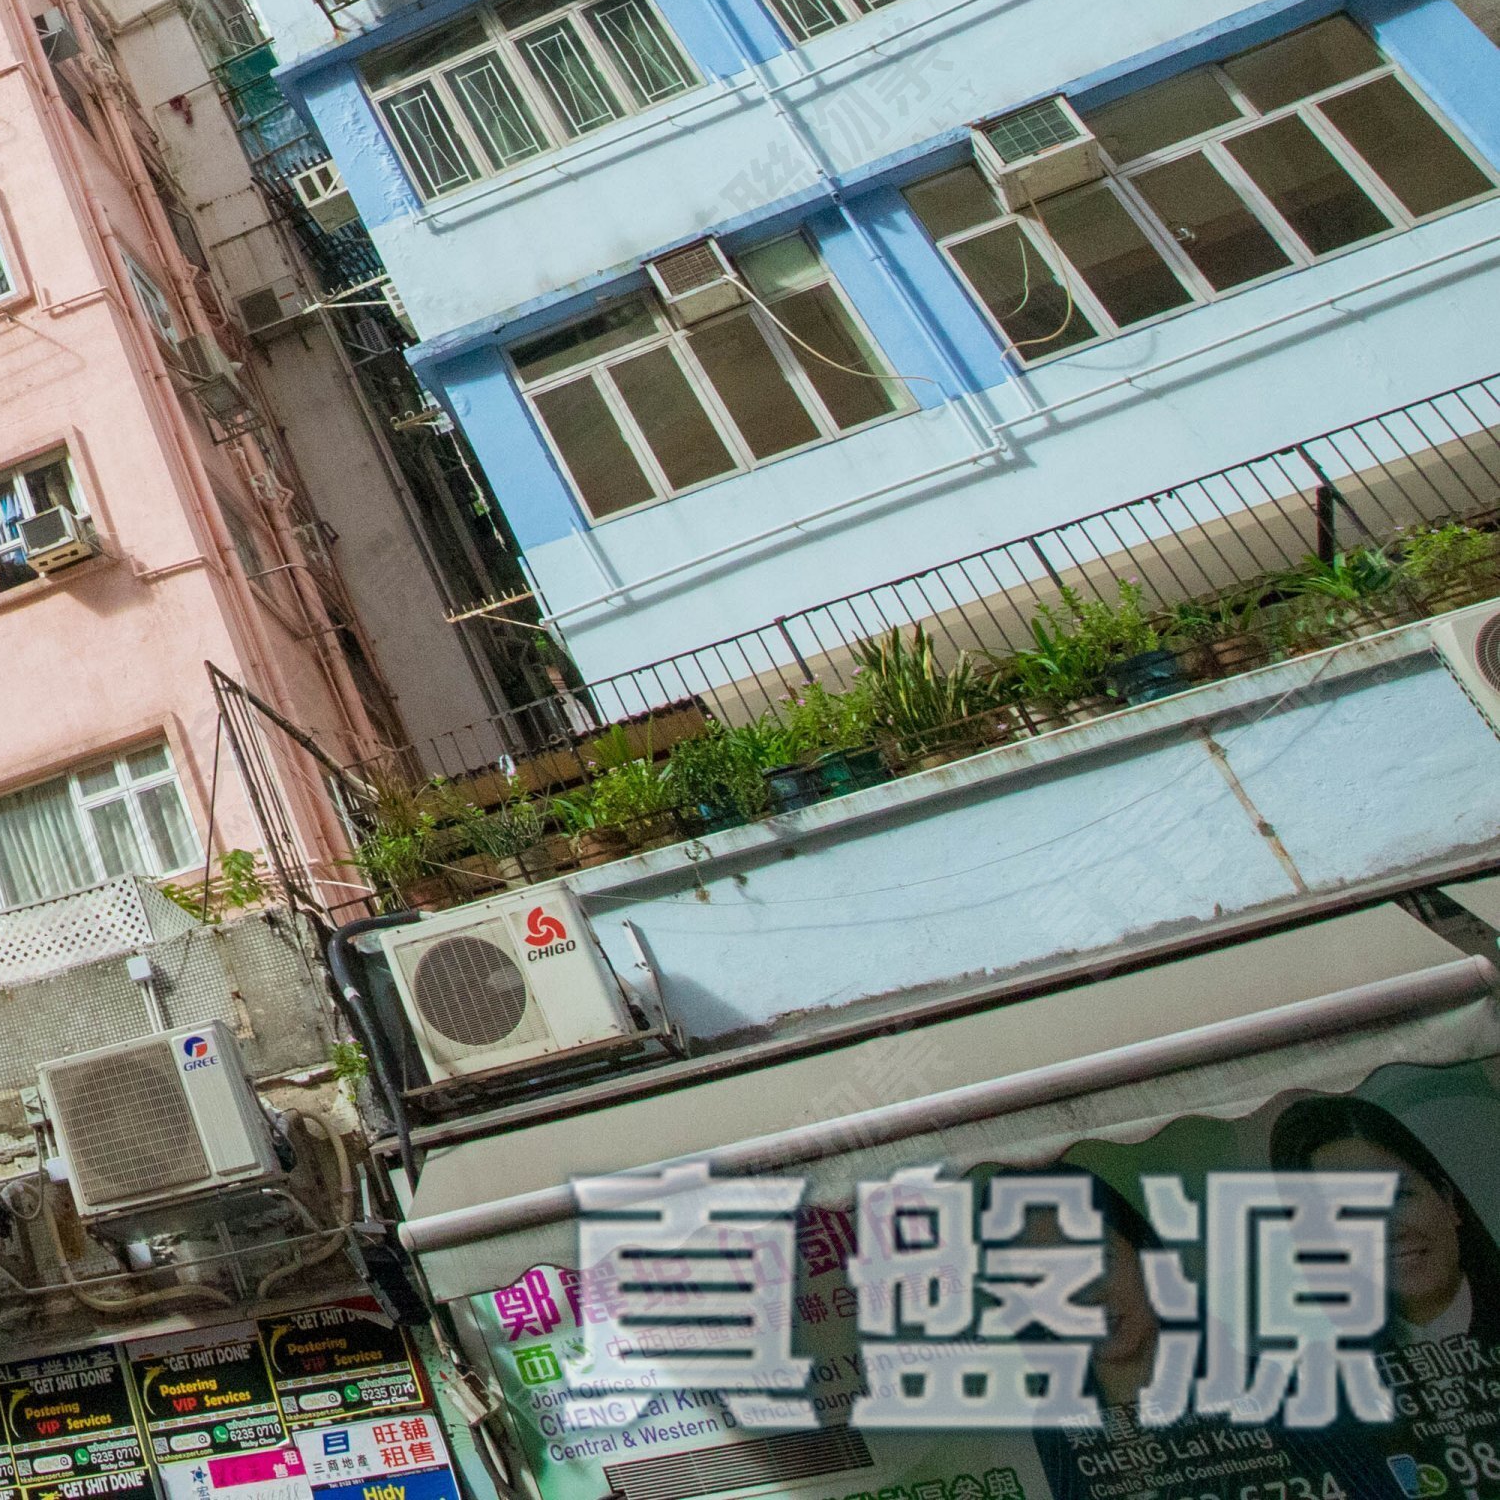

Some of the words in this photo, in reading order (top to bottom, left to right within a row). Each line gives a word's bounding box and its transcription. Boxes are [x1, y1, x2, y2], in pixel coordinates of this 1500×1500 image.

[525, 939, 576, 961] CHIGO
[184, 1054, 220, 1071] GREE
[287, 1337, 347, 1356] Postering
[191, 1349, 215, 1368] SHIT
[334, 1349, 384, 1367] Services
[55, 1374, 78, 1390] SHIT
[159, 1379, 218, 1397] Postering
[361, 1387, 387, 1401] 6235
[389, 1383, 415, 1397] 0710
[531, 1386, 574, 1411] Joint
[579, 1377, 634, 1401] Office
[640, 1369, 658, 1389] of
[172, 1397, 198, 1412] VIP
[203, 1390, 252, 1408] Services
[1420, 1381, 1471, 1412] Hoi
[24, 1402, 81, 1420] Postering
[540, 1399, 627, 1438] CHENG
[631, 1393, 670, 1421] Lai
[673, 1383, 730, 1413] King
[37, 1419, 60, 1435] VIP
[66, 1413, 113, 1430] Services
[230, 1428, 255, 1442] 6235
[257, 1423, 282, 1437] 0710
[372, 1416, 429, 1445] 旺舖
[1412, 1419, 1463, 1442] (Tung
[1458, 1409, 1498, 1429] Wah
[549, 1433, 619, 1463] Central
[622, 1430, 637, 1449] &
[638, 1415, 720, 1445] Western
[90, 1452, 115, 1464] 6235
[117, 1447, 141, 1460] 0710
[380, 1441, 436, 1469] 租售
[1076, 1441, 1168, 1478] CHENG
[1170, 1431, 1211, 1461] Lai
[1213, 1424, 1274, 1452] King
[312, 1453, 370, 1475] 三商地產
[1089, 1476, 1143, 1500] (Castle
[1142, 1470, 1184, 1490] Road
[1185, 1448, 1293, 1484] Constituency)
[85, 1477, 108, 1495] SHIT
